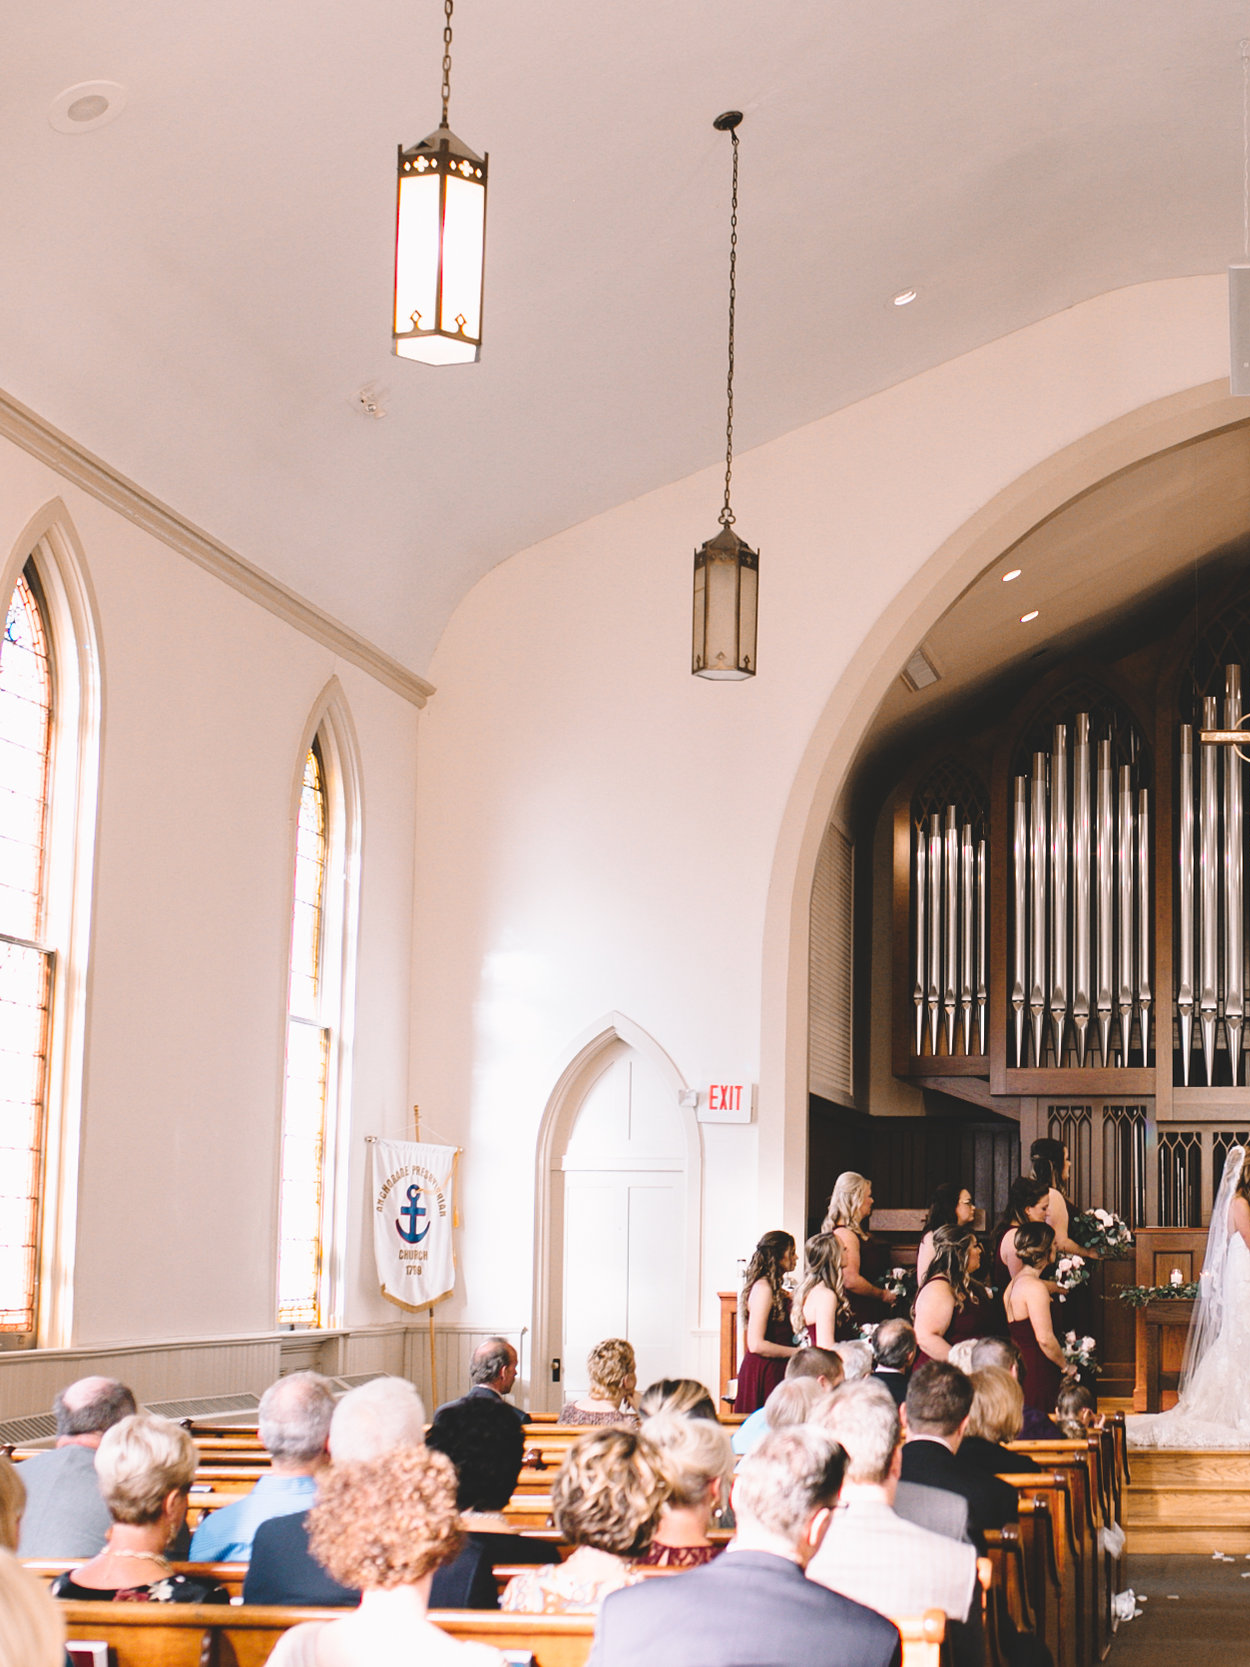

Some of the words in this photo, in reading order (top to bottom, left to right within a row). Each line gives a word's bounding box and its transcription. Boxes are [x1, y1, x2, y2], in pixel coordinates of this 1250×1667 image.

[709, 1084, 744, 1111] EXIT
[376, 1165, 410, 1213] ANCHORAGE
[398, 1249, 428, 1261] CHURCH
